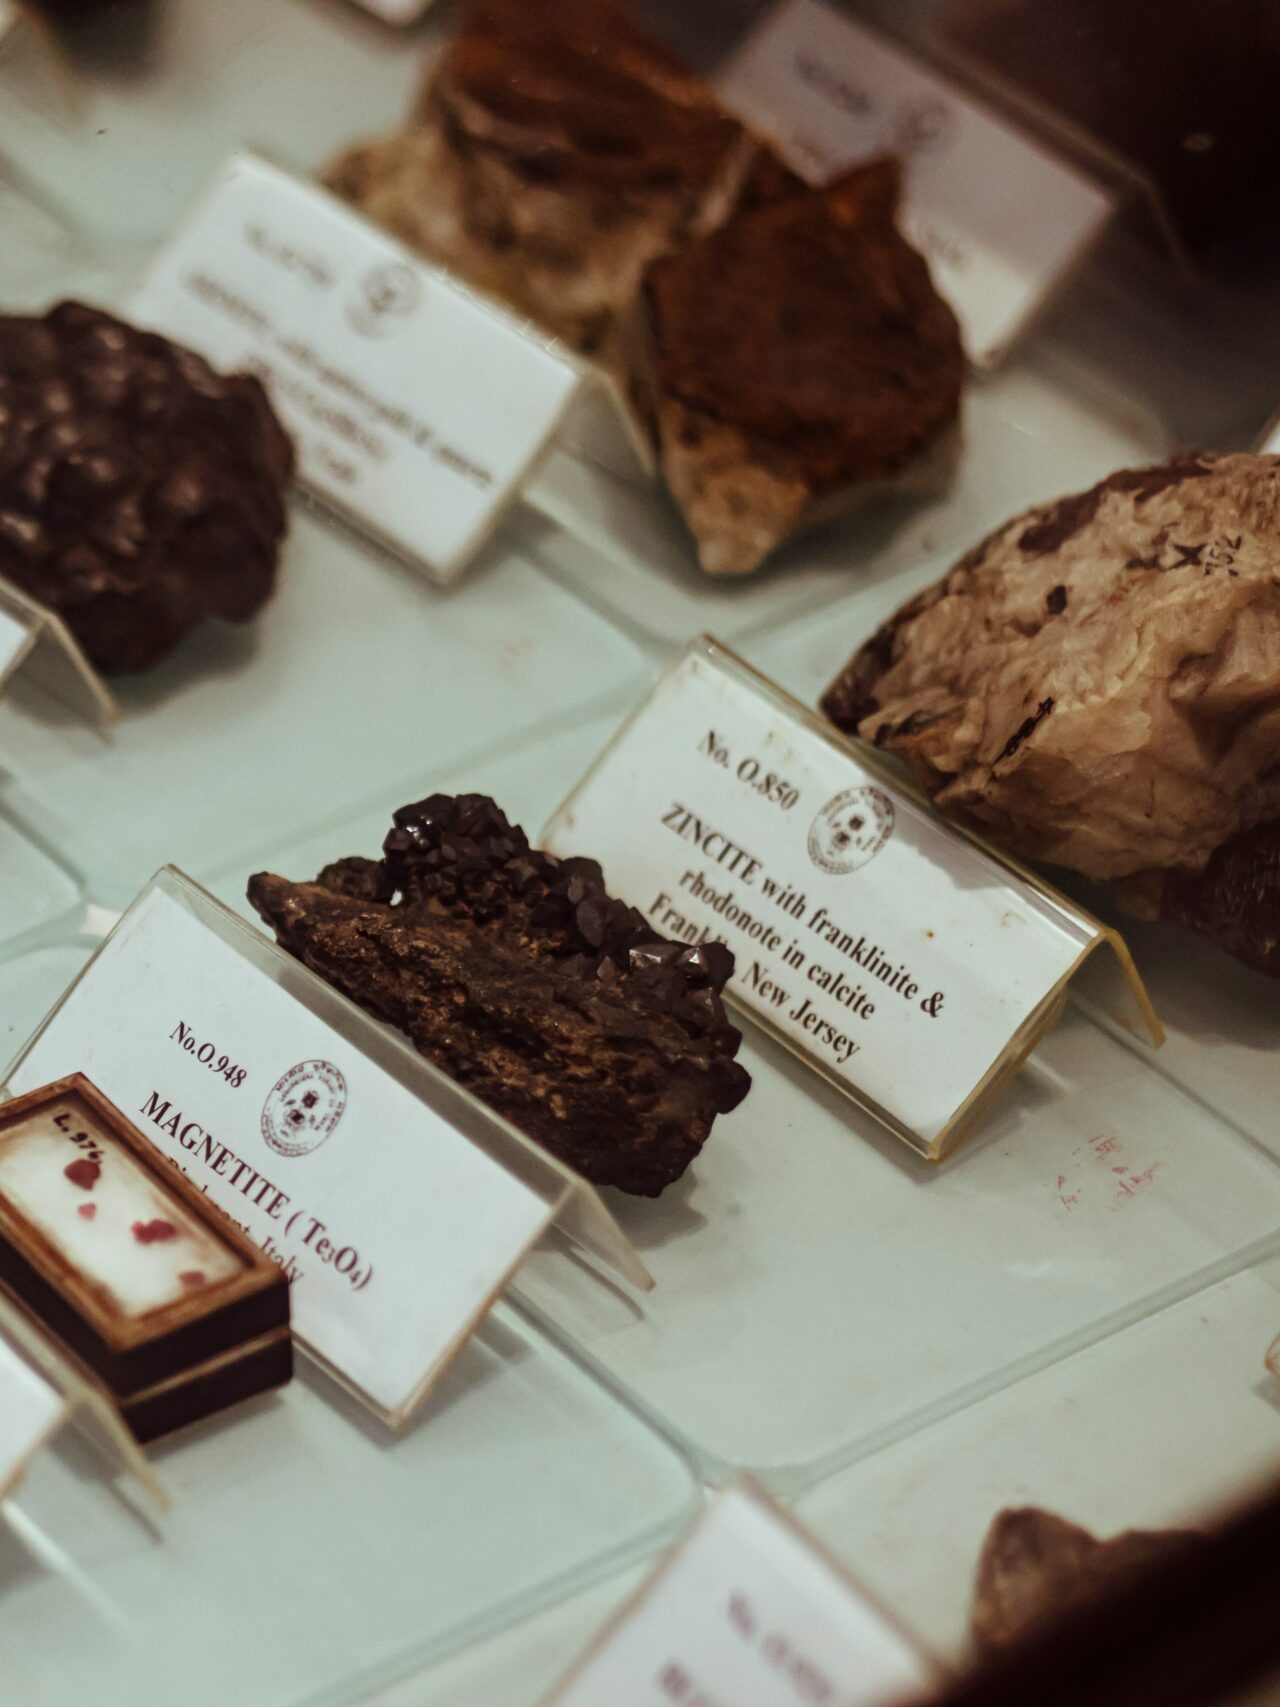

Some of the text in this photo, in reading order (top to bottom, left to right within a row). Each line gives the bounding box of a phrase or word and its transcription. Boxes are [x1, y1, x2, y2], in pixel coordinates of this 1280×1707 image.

[698, 728, 799, 809] No. O.850
[662, 804, 762, 885] ZINCITE
[762, 878, 806, 919] with
[808, 909, 918, 999] franklinite
[920, 992, 944, 1018] &
[680, 871, 875, 1019] rhodonote in calcite
[741, 960, 792, 1008] New
[788, 998, 861, 1064] Jersey
[140, 1091, 290, 1219] MAGNETITE
